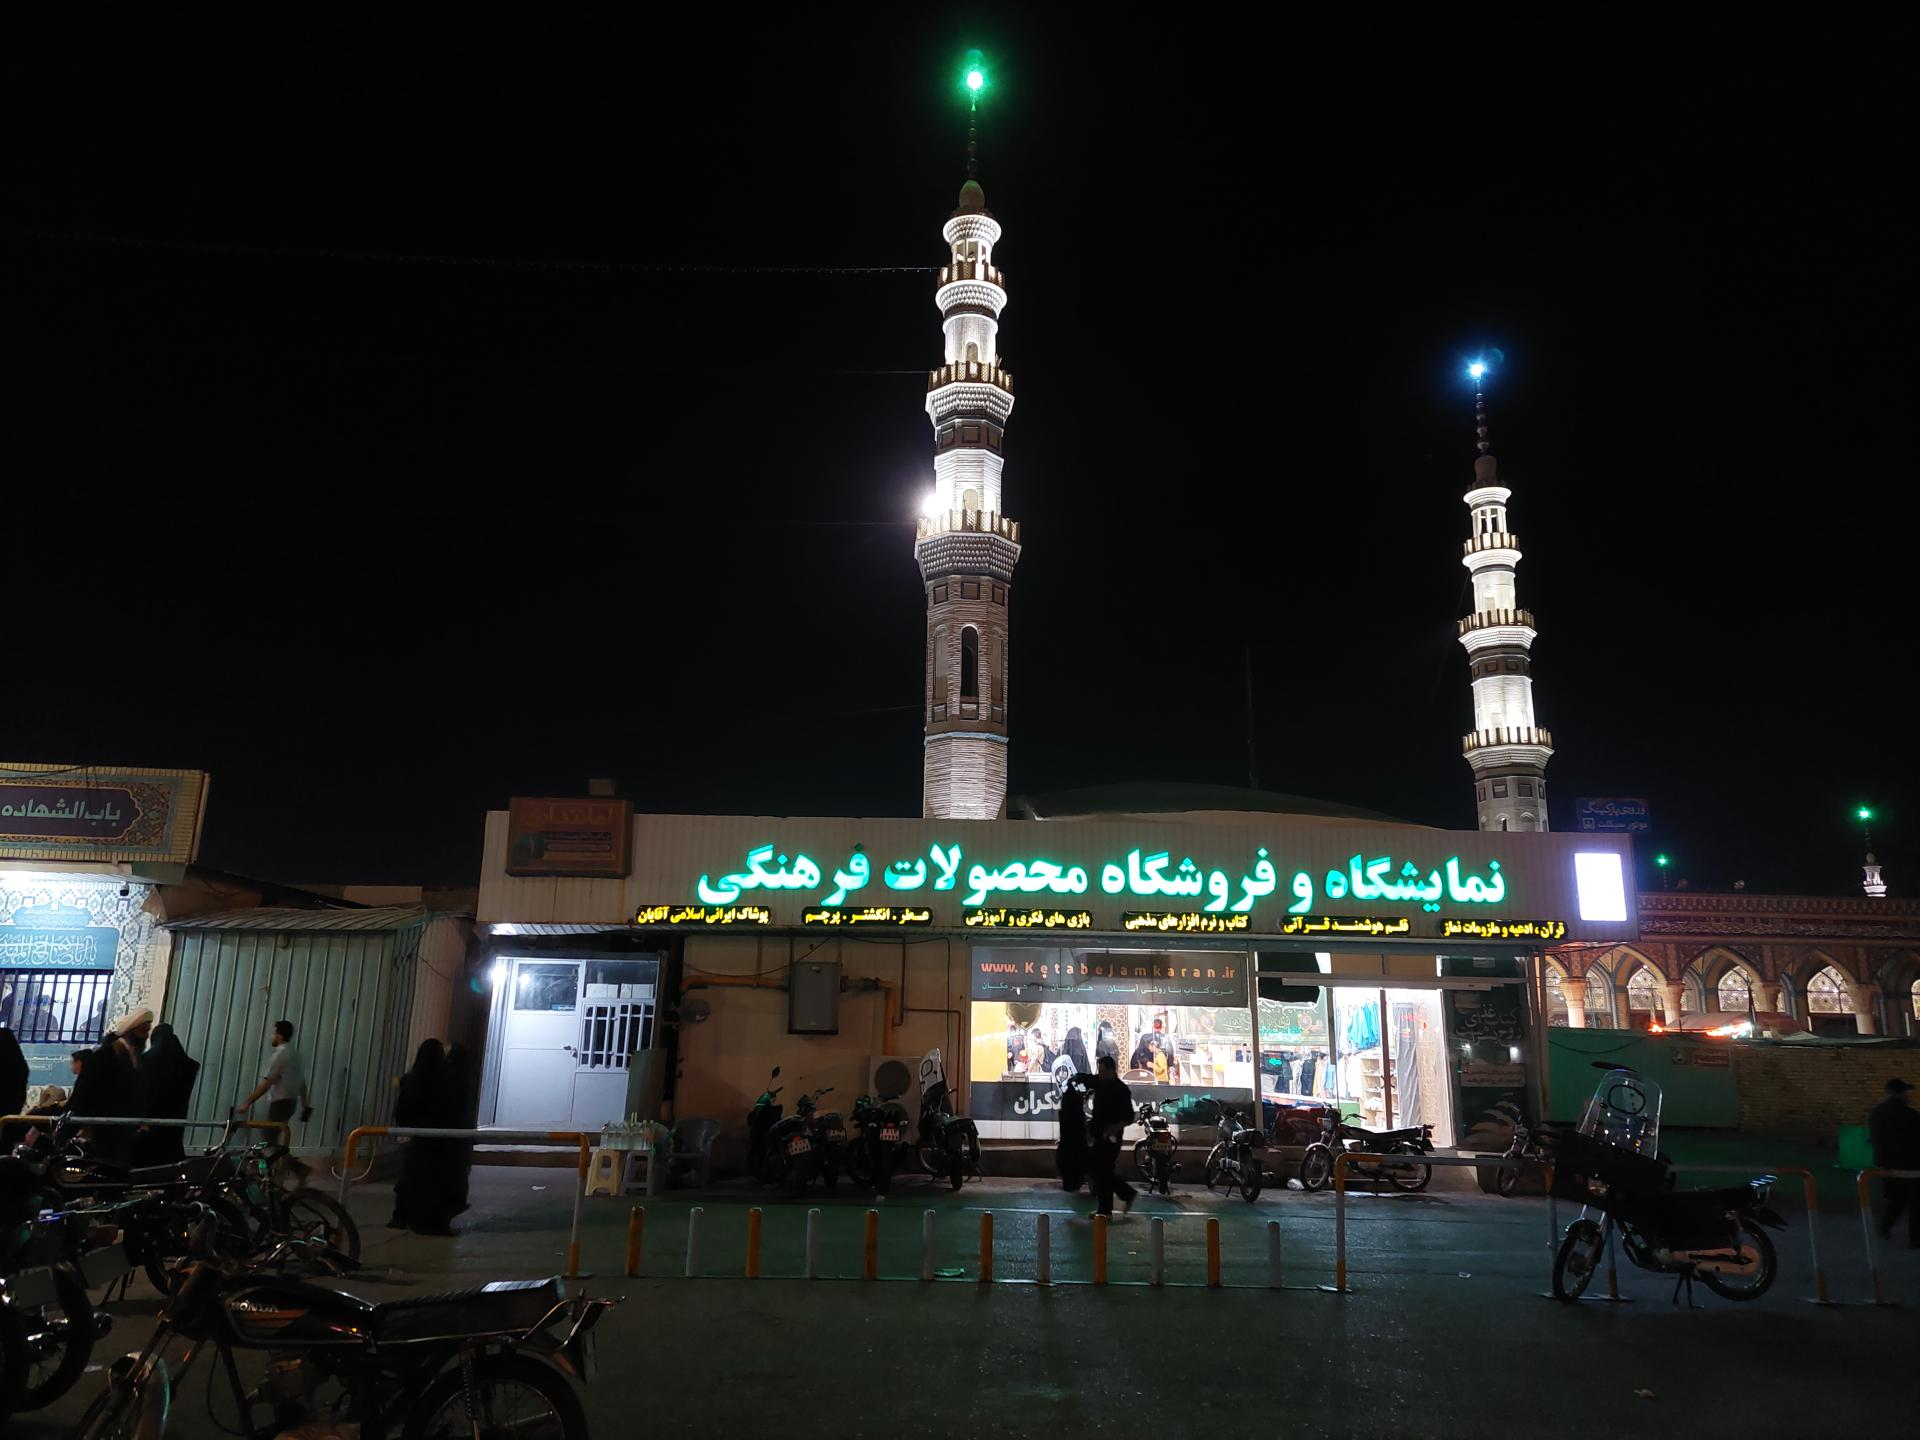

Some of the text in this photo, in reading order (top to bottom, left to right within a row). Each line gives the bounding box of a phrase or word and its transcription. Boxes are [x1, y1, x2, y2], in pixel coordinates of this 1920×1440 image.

[1, 798, 121, 827] باب الشهاده
[698, 843, 1506, 912] نمایشگاه و فروشگاه محصولات فرهنگی
[637, 906, 769, 924] پوشاک ایرانی اسلامی آقایان
[805, 910, 841, 925] پرچم
[849, 908, 890, 924] انگشتر
[899, 908, 930, 924] عطر
[965, 909, 1091, 928] بازی های فکری و آموزشی
[1125, 912, 1157, 930] مذهبی
[1201, 914, 1217, 931] نرم
[1225, 914, 1248, 931] کتاب
[1218, 918, 1225, 931] و
[1283, 916, 1409, 934] قلم هوشمند قرآنی
[1444, 920, 1461, 936] نماز
[1463, 921, 1500, 937] ملزومات
[1502, 926, 1508, 937] و
[1508, 923, 1533, 937] ادعیه
[1050, 983, 1074, 993] زمان
[1107, 983, 1139, 993] آسان
[1184, 984, 1210, 995] کتاب
[1213, 986, 1235, 996] خرید
